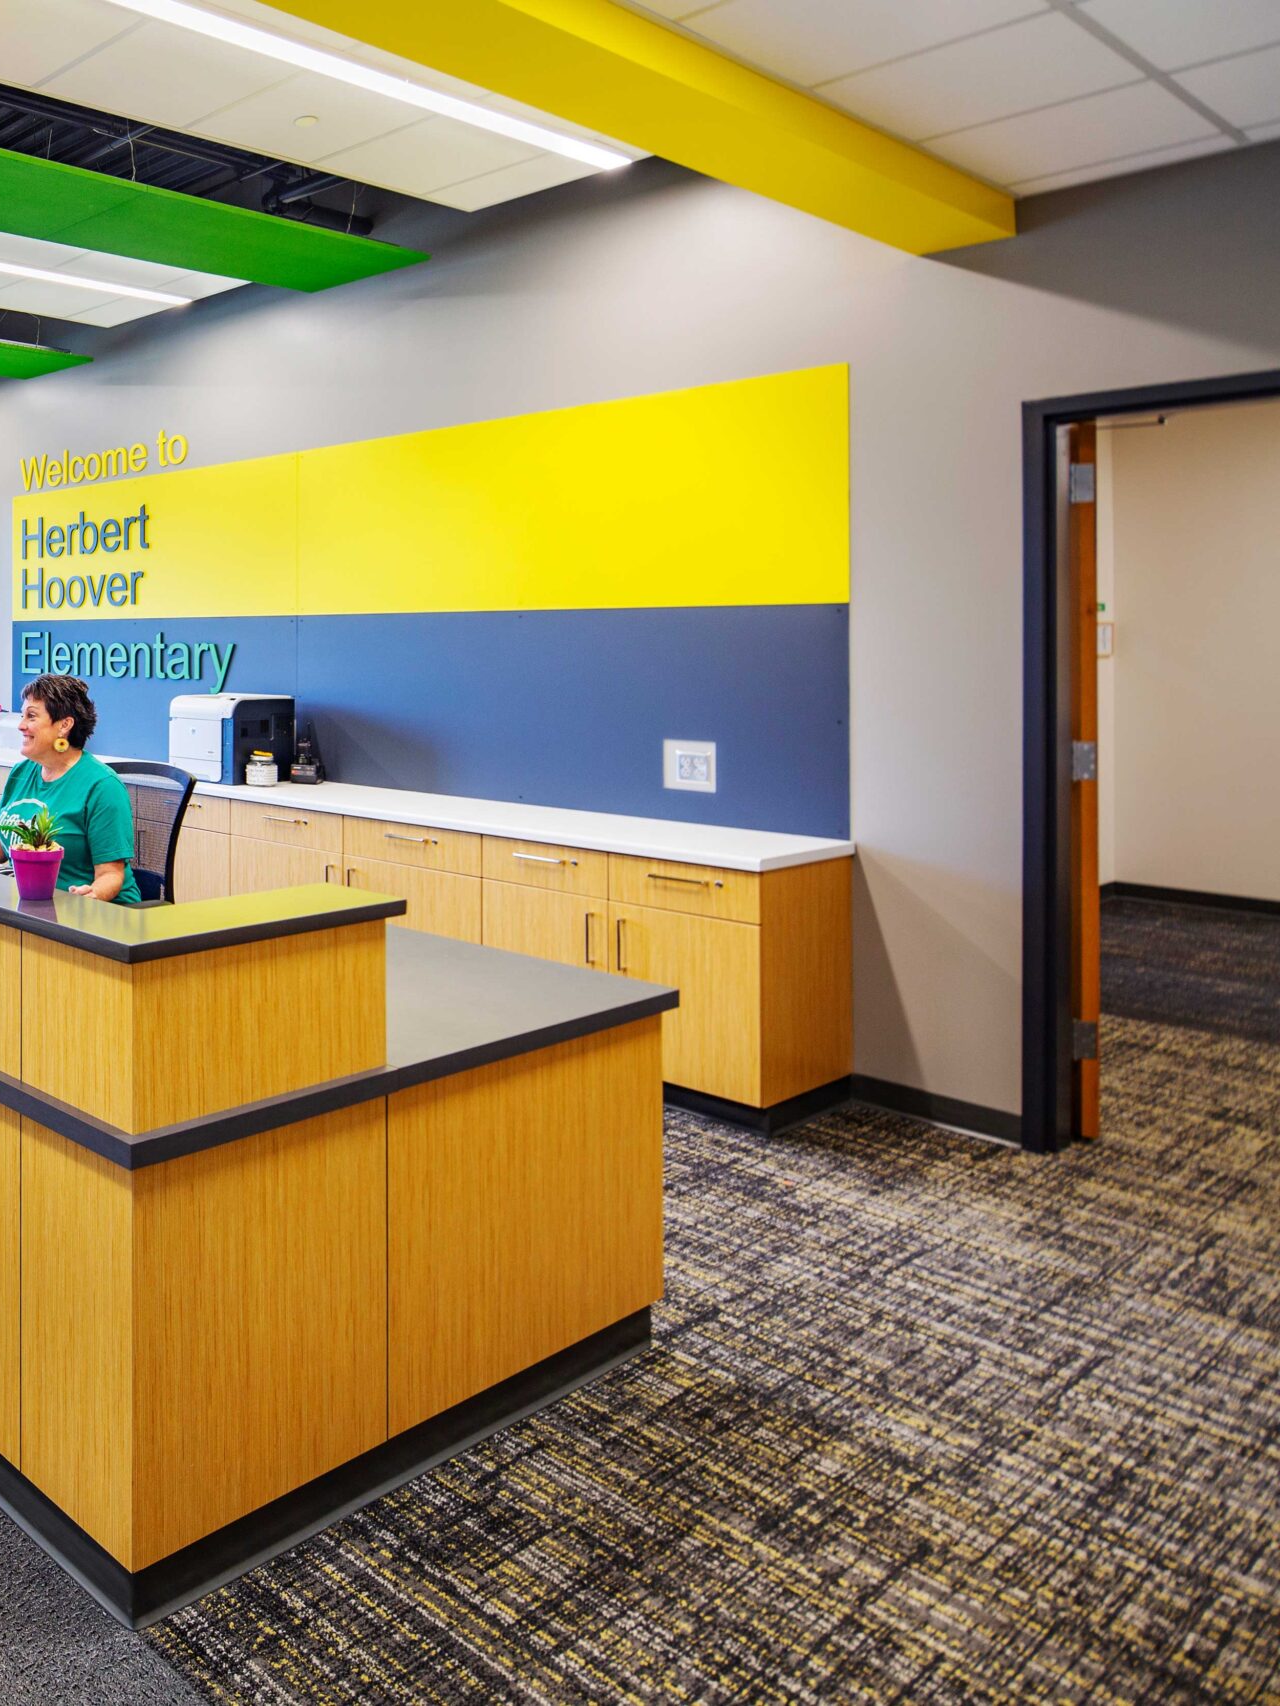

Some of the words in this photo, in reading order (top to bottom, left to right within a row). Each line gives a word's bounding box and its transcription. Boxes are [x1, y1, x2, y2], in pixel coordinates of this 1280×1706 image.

[20, 442, 148, 492] Welcome
[156, 429, 189, 468] to
[21, 503, 150, 560] Herbert
[21, 567, 145, 610] Hoover
[21, 630, 237, 695] Elementary
